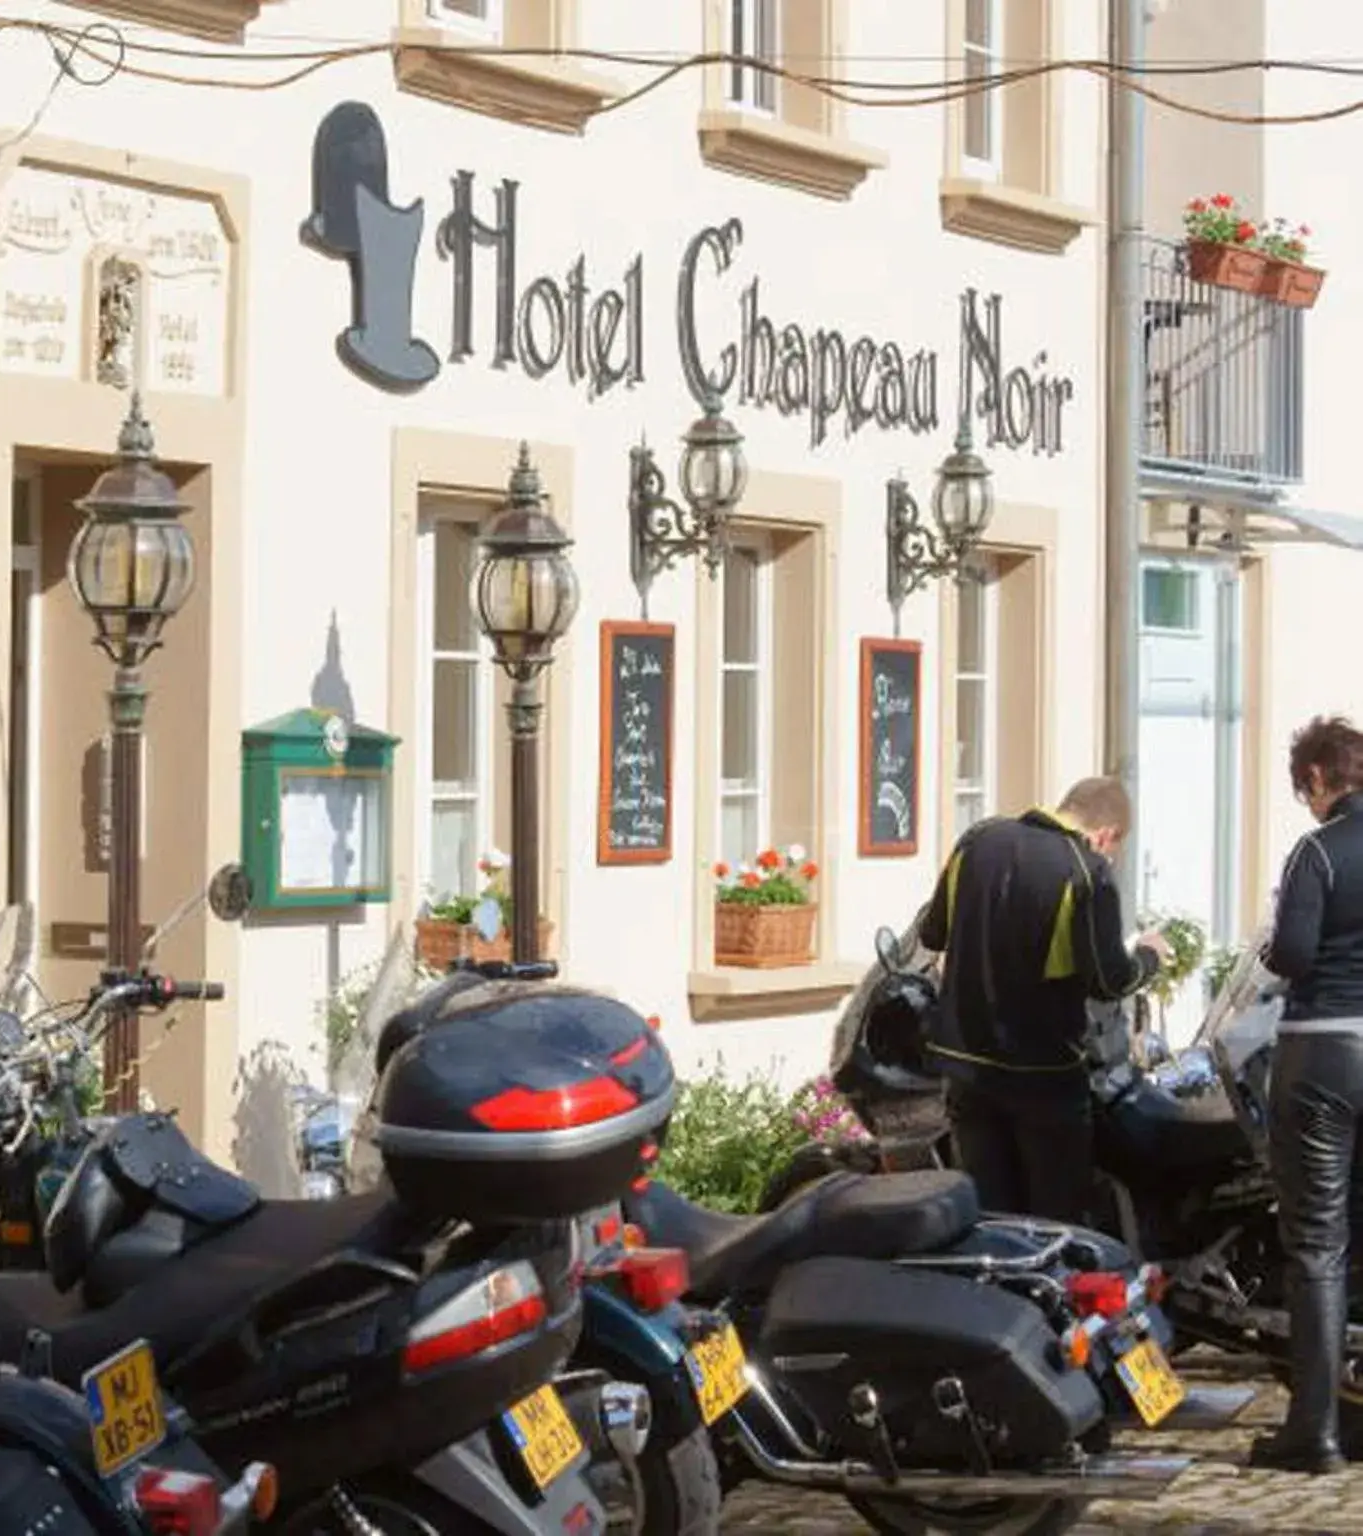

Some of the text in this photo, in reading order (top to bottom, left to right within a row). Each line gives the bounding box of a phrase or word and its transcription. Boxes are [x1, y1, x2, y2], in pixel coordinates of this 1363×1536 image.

[437, 169, 1073, 457] Hotel Chapeau Noir
